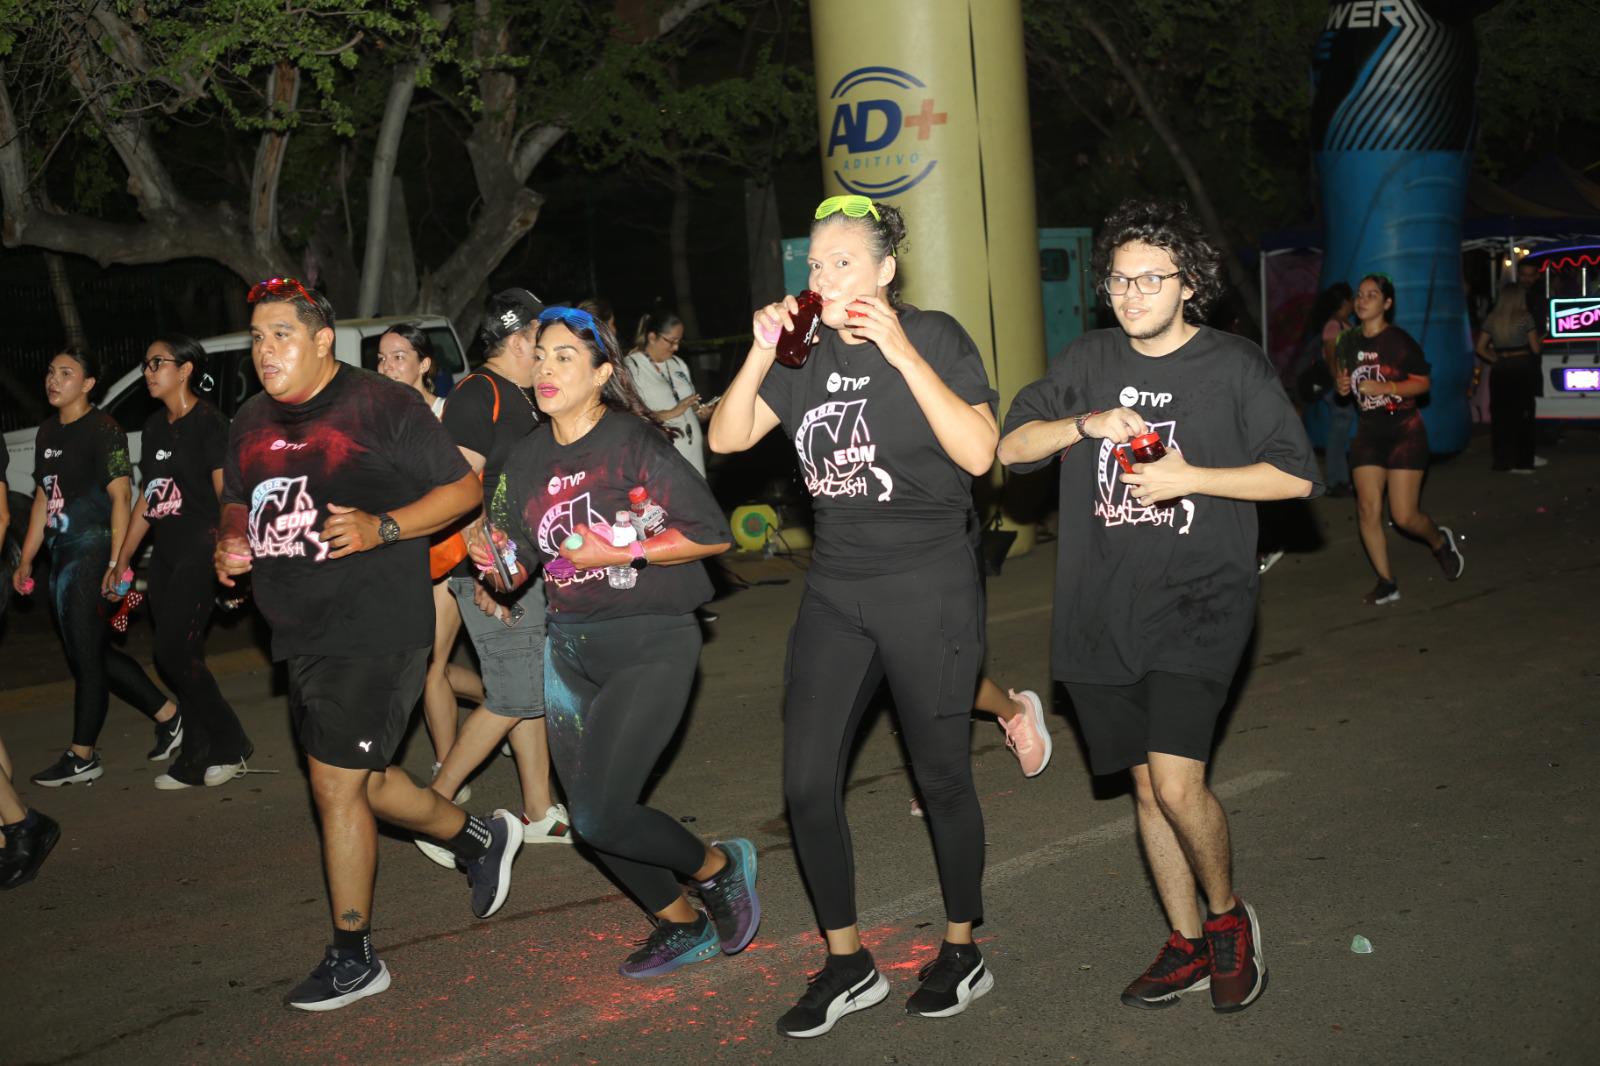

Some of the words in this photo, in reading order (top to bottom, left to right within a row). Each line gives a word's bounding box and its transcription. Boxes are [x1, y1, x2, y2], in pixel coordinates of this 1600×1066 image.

[843, 152, 920, 171] ADITIVO
[500, 310, 518, 326] 35
[841, 376, 870, 391] TVP
[1138, 391, 1172, 407] TVP
[561, 471, 586, 490] TVP
